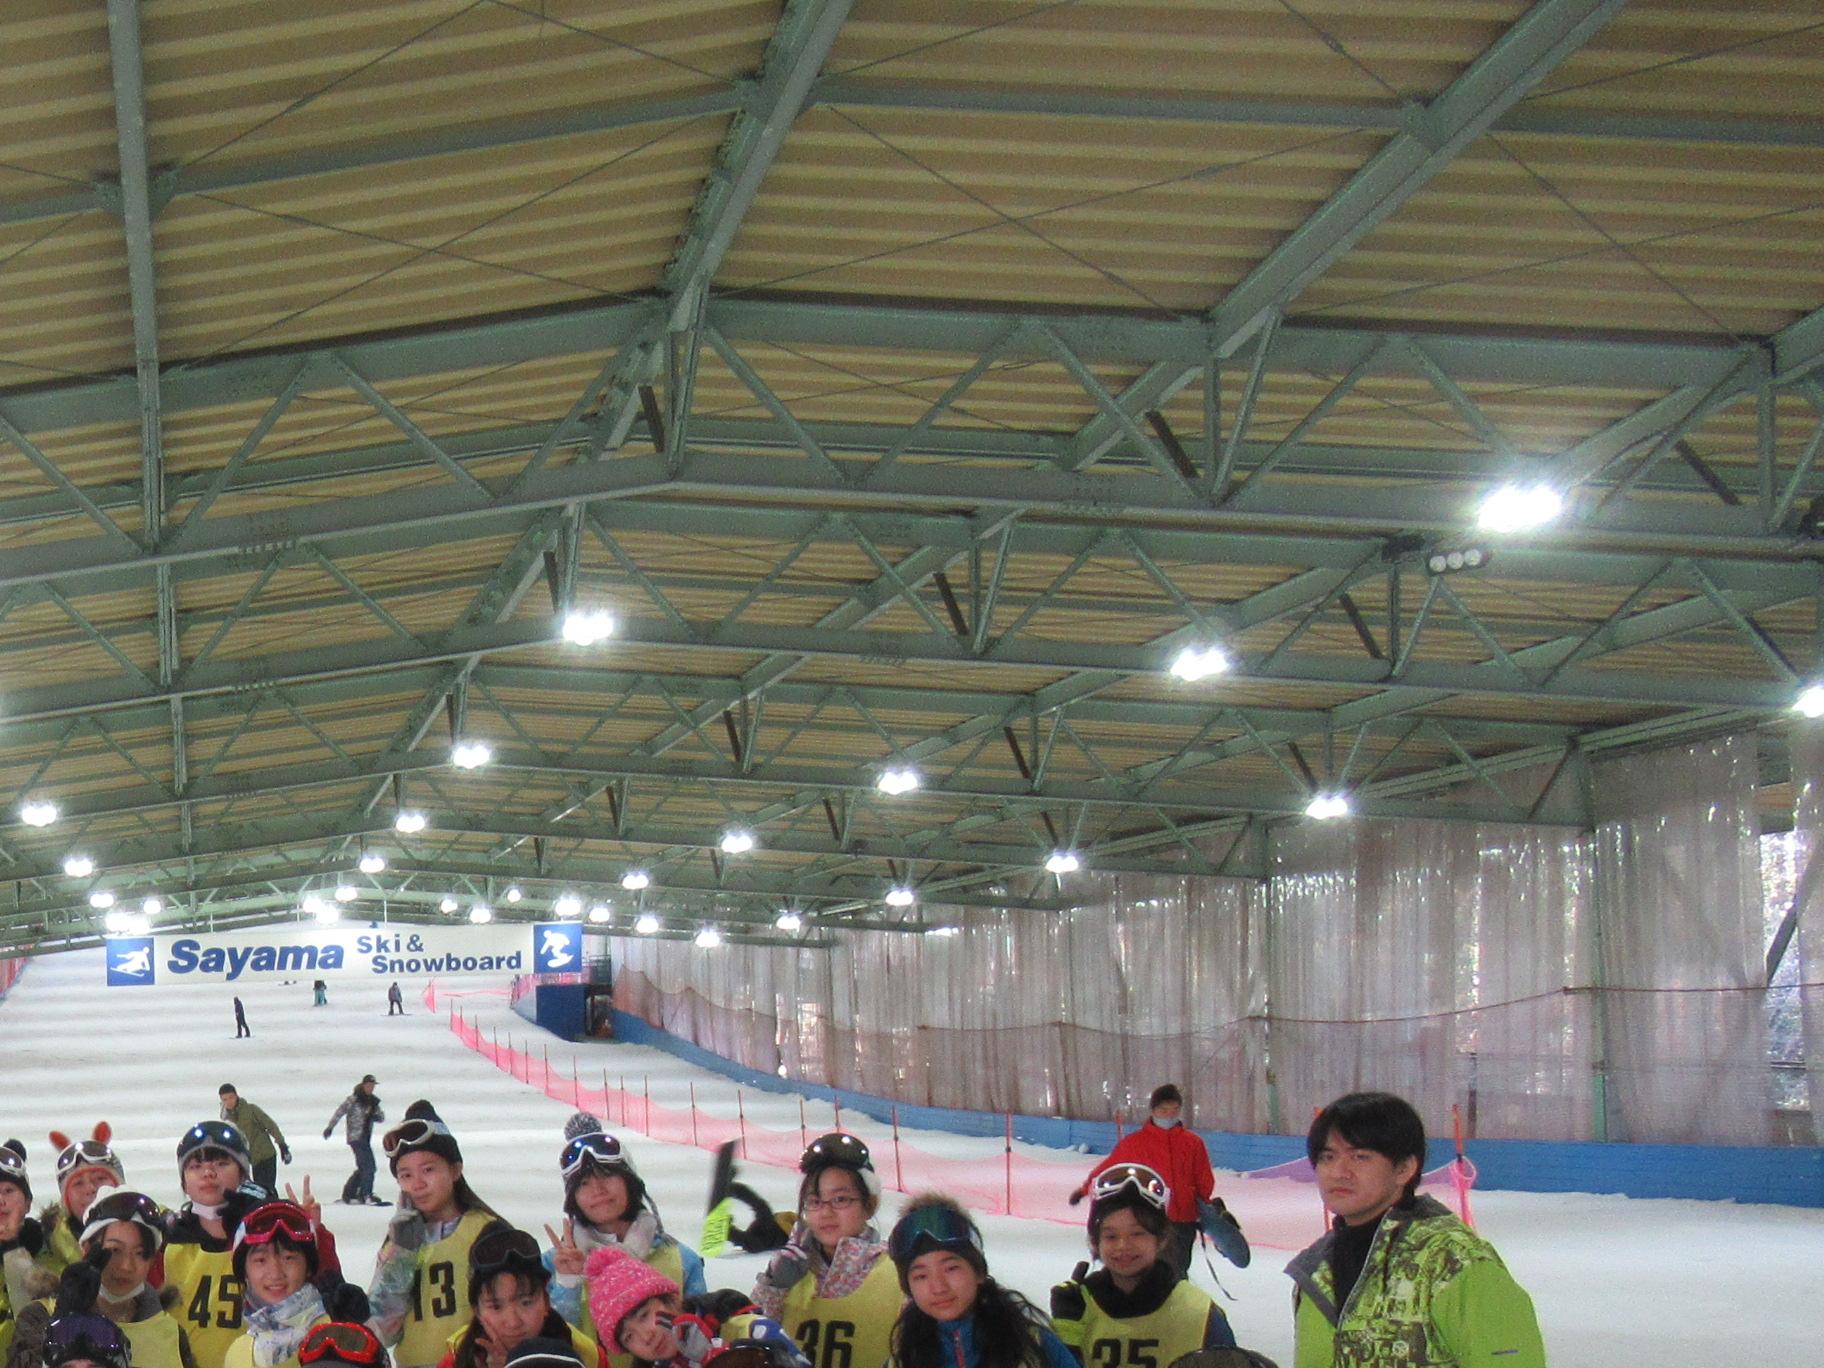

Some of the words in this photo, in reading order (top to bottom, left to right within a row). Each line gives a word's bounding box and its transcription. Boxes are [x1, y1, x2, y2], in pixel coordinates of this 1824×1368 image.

[167, 939, 344, 981] Sayama
[357, 933, 401, 954] Ski
[406, 933, 424, 953] &
[371, 951, 522, 974] Snowboard
[188, 1275, 242, 1329] 45
[412, 1261, 457, 1322] 13
